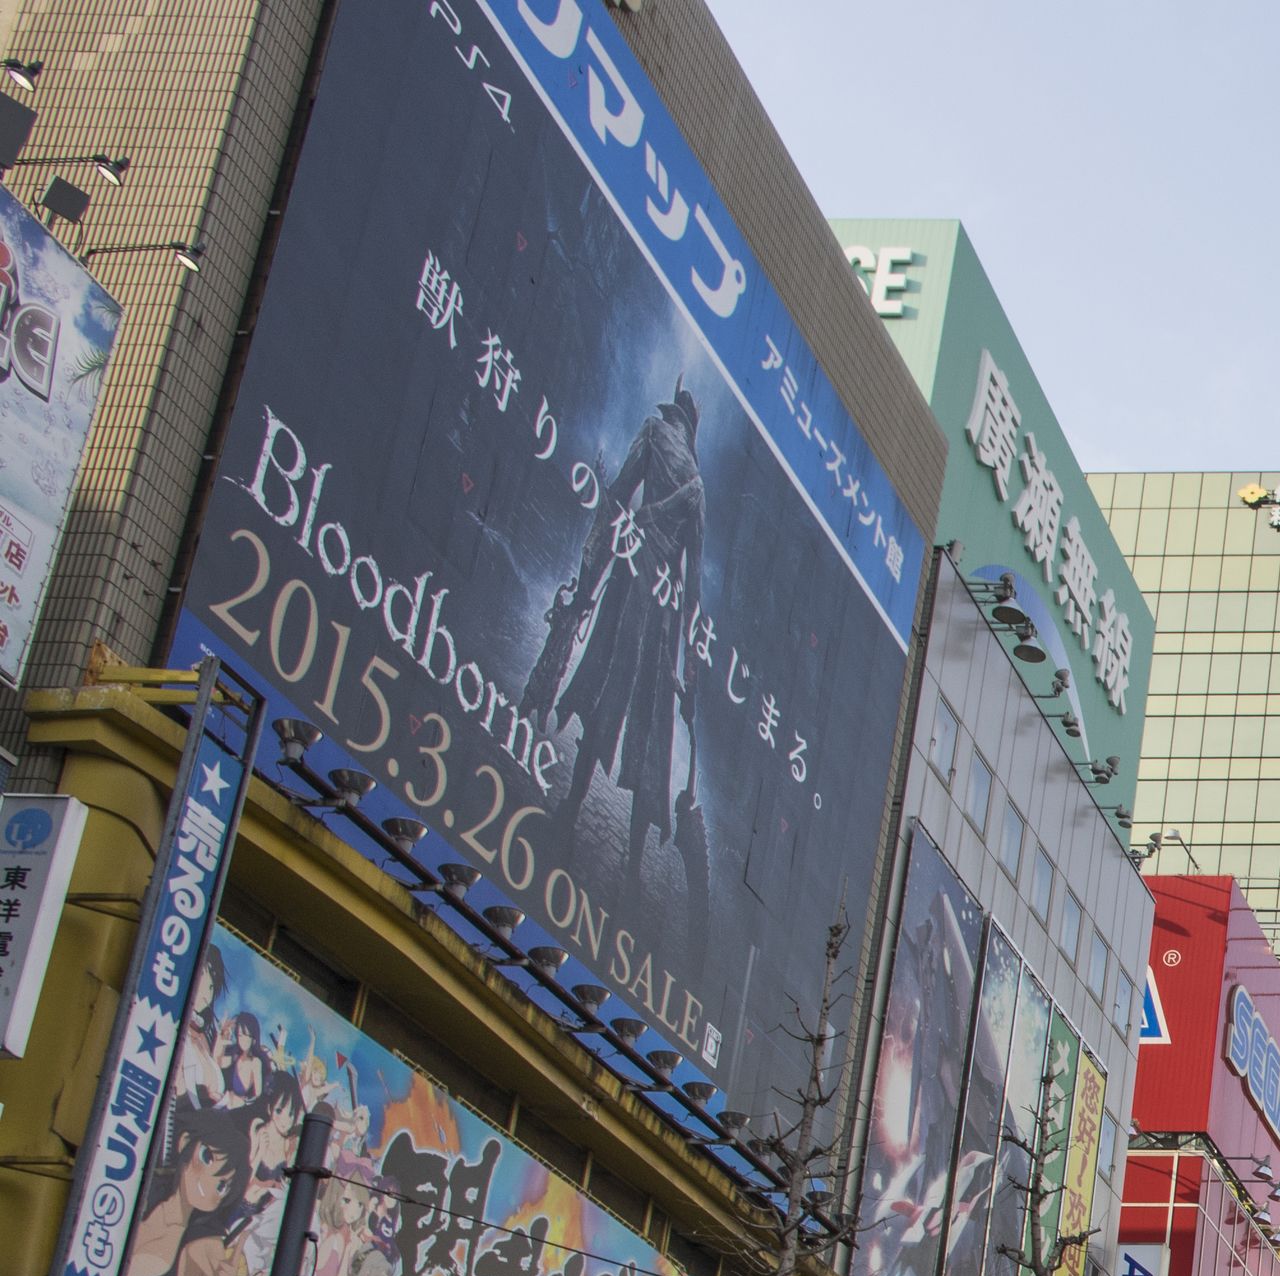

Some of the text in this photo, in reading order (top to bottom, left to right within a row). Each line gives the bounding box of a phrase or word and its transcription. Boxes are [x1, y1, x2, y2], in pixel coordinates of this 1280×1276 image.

[761, 334, 905, 584] アミューズメント館
[224, 405, 566, 796] Bloodborne
[152, 797, 224, 1000] 売るのも
[209, 529, 704, 1053] 2015.3.26 ON SALE
[83, 1060, 162, 1271] 買うのも
